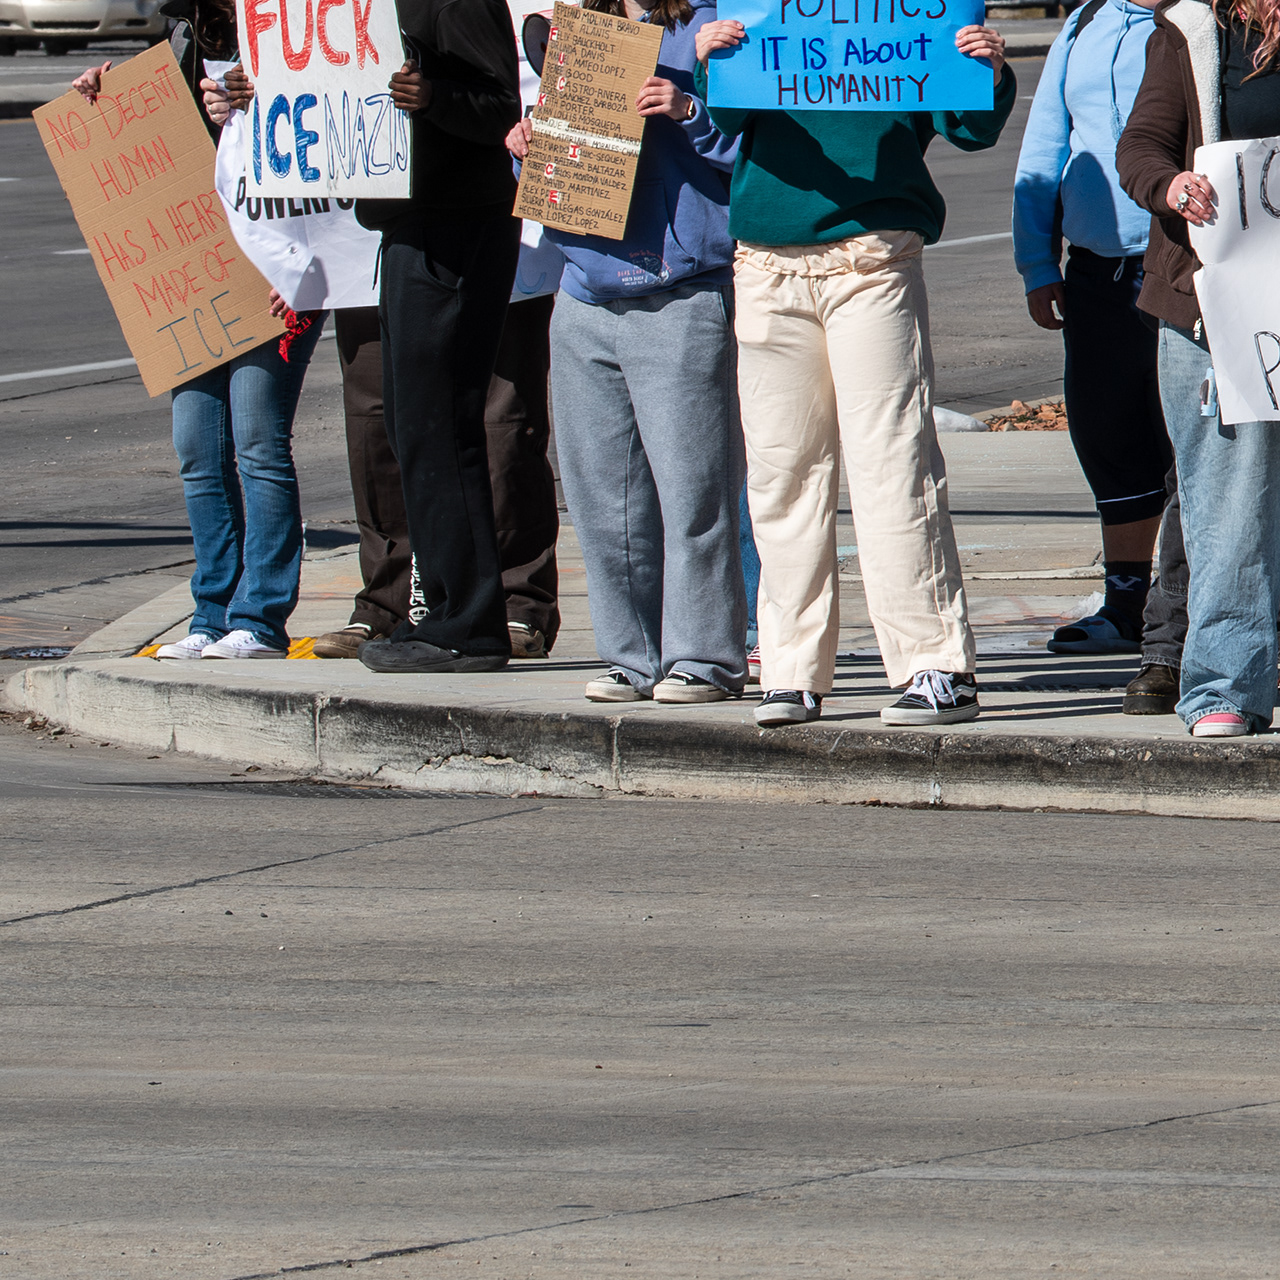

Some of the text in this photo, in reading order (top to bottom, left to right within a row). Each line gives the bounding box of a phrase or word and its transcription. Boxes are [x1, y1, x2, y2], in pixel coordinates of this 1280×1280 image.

[574, 59, 599, 73] MATEO
[600, 64, 626, 79] LOPEZ
[581, 47, 605, 62] DAVIS
[761, 36, 788, 71] IT
[802, 37, 827, 69] IS
[566, 69, 593, 82] GOOD
[46, 63, 180, 158] NO DECENT
[560, 100, 594, 116] PORTER
[252, 90, 320, 185] ICE
[91, 135, 176, 202] HUMAN
[568, 184, 611, 200] MARTINEZ
[147, 218, 168, 252] A
[547, 211, 573, 225] LOPEZ
[575, 216, 599, 229] LOPEZ
[132, 240, 237, 318] MADE OF
[157, 290, 254, 376] ICE
